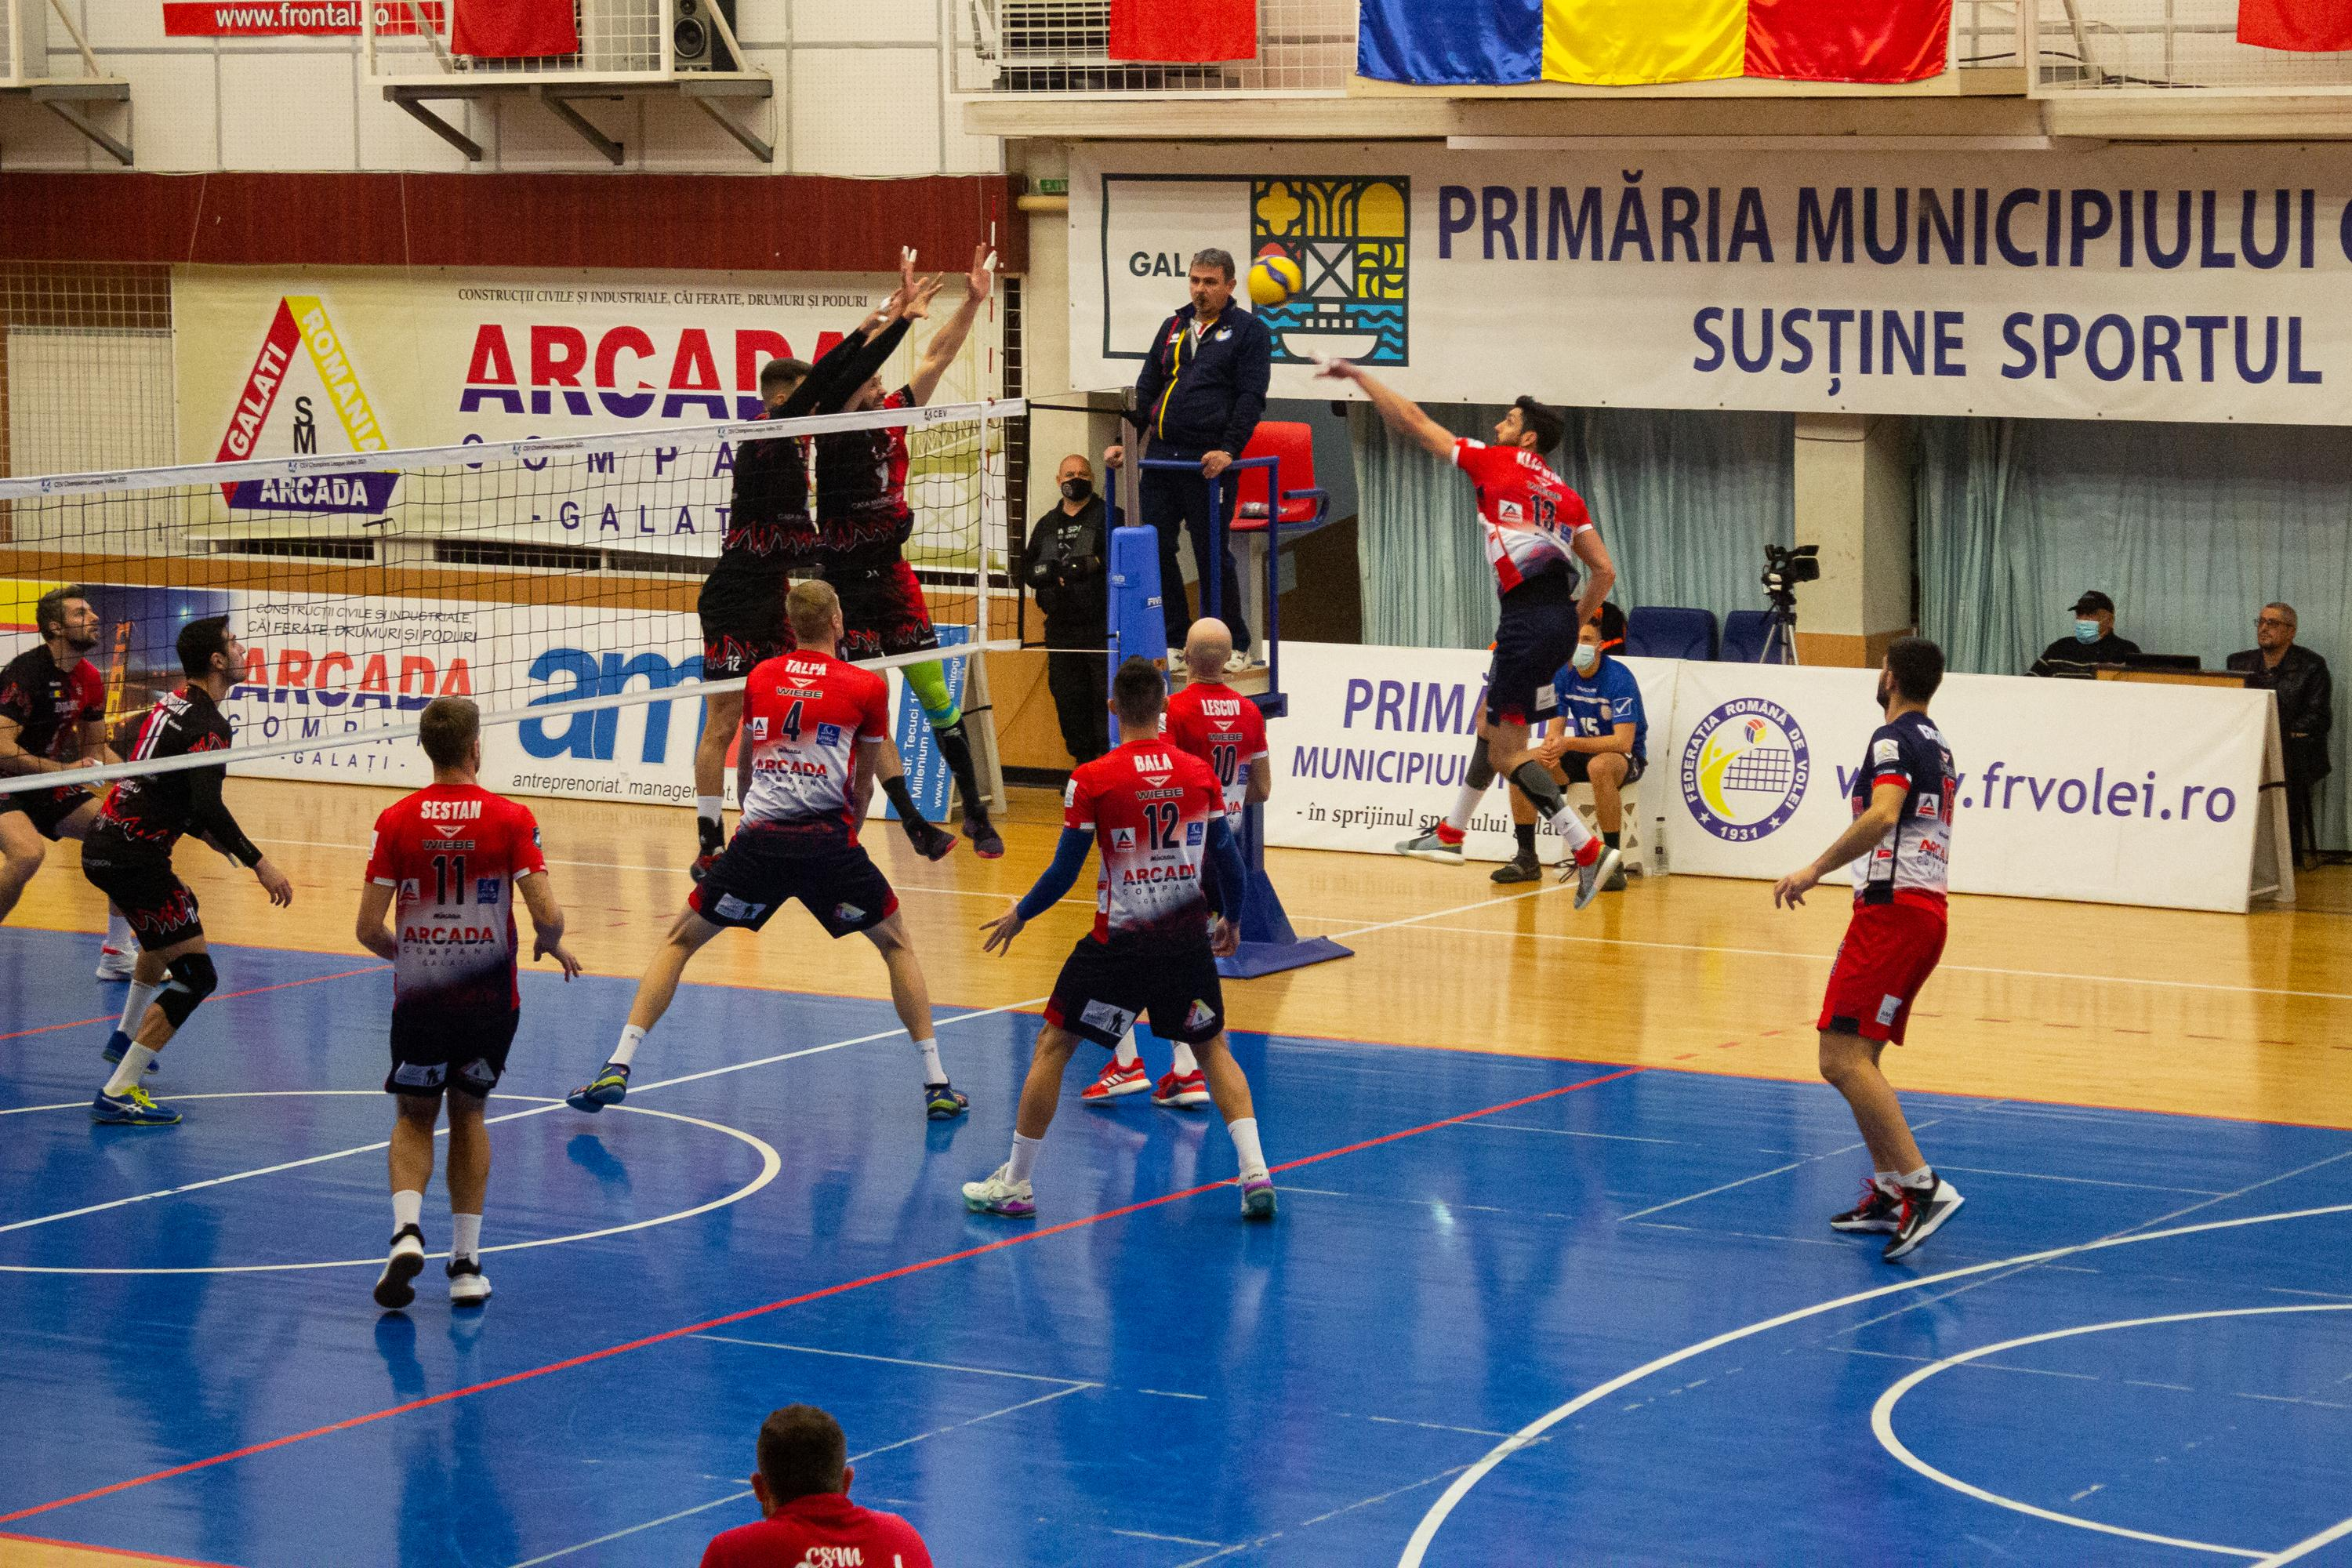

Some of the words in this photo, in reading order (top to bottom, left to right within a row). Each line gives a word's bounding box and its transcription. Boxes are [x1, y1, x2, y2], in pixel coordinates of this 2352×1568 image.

[215, 2, 390, 27] www.frontal.o
[1439, 169, 1775, 263] PRIMĂRIA
[1795, 187, 2315, 270] MUNICIPIULUI
[1129, 251, 1190, 278] GAL
[536, 289, 575, 303] CIVILE
[590, 290, 670, 307] INDUSTRIALE,
[695, 292, 745, 308] FERATE,
[747, 293, 806, 307] DRUMURI
[822, 294, 868, 308] PODURI
[1693, 305, 1966, 397] SUSȚINE
[2000, 311, 2323, 385] SPORTUL
[459, 324, 847, 421] ARCAD
[260, 477, 368, 506] ARCADA
[336, 606, 372, 619] CIVILE
[784, 659, 827, 676] TALPA
[775, 685, 823, 699] WIEBE
[1200, 699, 1241, 717] LESCOV
[781, 699, 804, 742] 4
[904, 709, 920, 750] Tecuci
[1788, 728, 1806, 751] DE
[911, 735, 930, 800] Millenium
[1133, 753, 1174, 773] BALA
[512, 773, 623, 795] antreprenoriat.
[1134, 787, 1184, 800] WIEBE
[1784, 759, 1809, 810] VOLEI
[1835, 760, 2237, 824] w.frvolei.ro
[419, 800, 483, 820] SESTAN
[1308, 802, 1327, 822] în
[1332, 804, 1414, 830] sprijinul
[1419, 812, 1508, 837] spului
[1142, 800, 1181, 851] 12
[1719, 826, 1759, 841] 1931
[422, 839, 476, 851] WIEBE
[431, 853, 466, 906] 11
[1122, 863, 1196, 886] ARCAD
[402, 926, 496, 946] ARCADA
